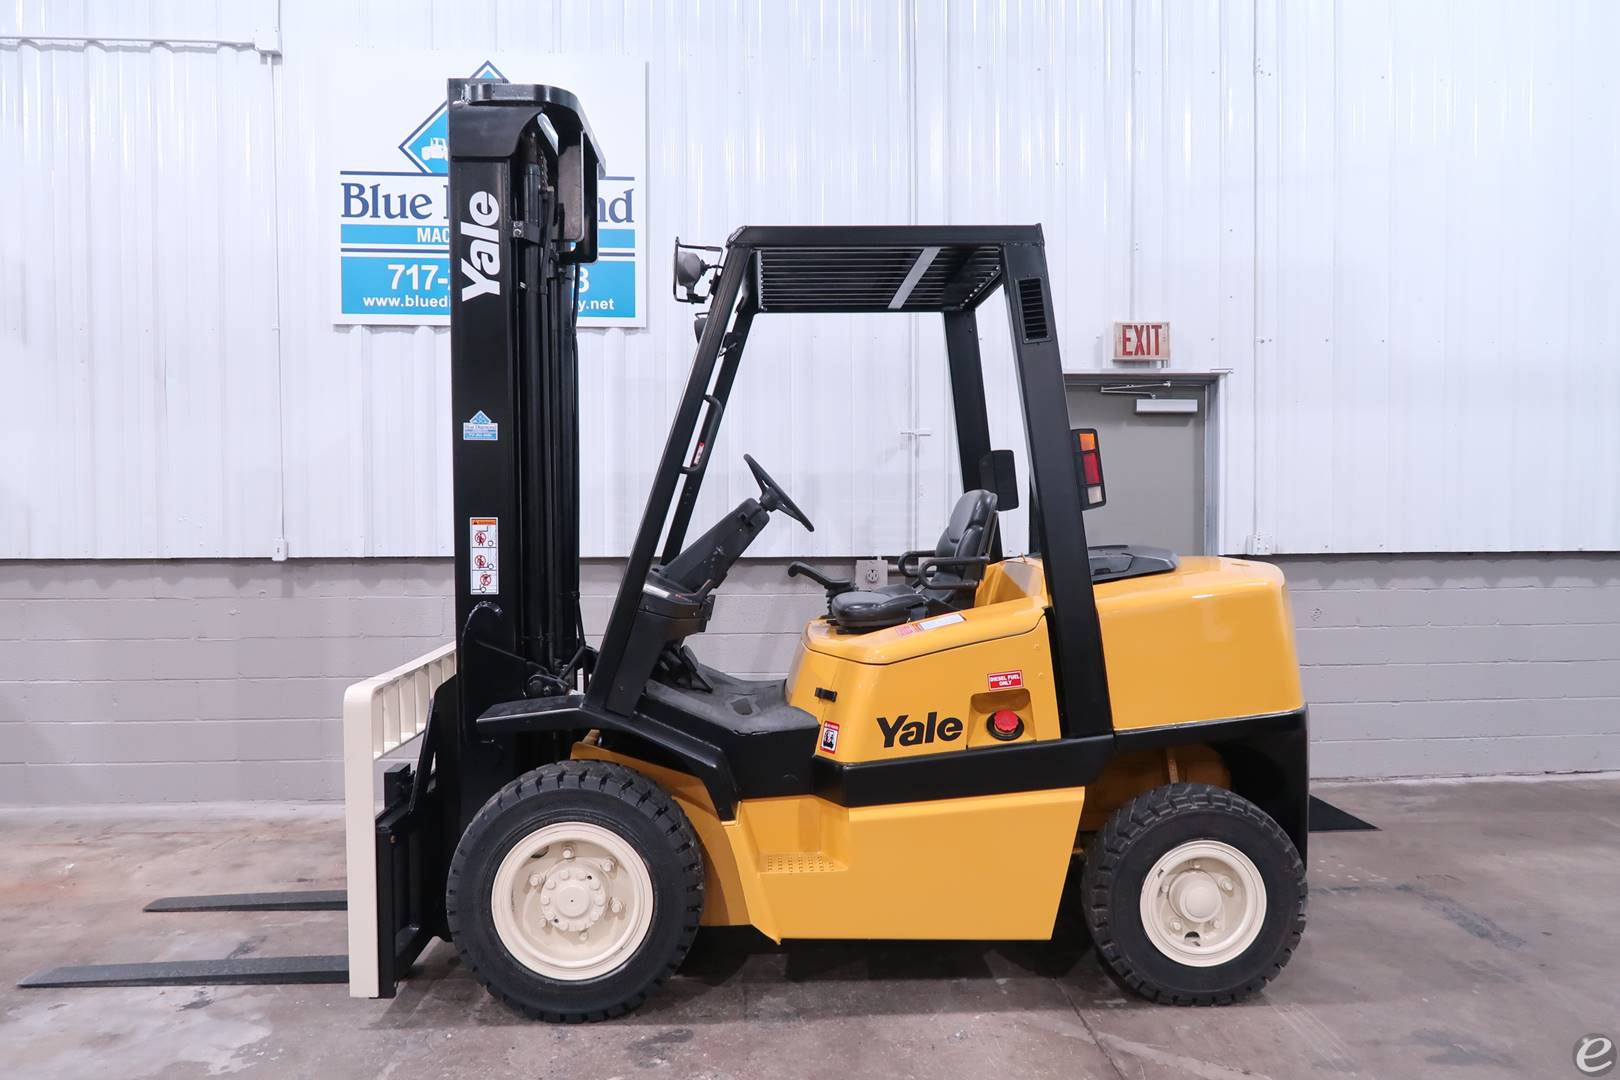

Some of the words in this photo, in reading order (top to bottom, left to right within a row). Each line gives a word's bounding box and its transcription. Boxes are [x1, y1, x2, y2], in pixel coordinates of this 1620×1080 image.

[340, 182, 433, 220] Blue
[598, 188, 635, 223] nd
[416, 227, 450, 243] MAC
[460, 190, 501, 302] Yale
[387, 264, 448, 291] 717-
[363, 294, 449, 307] www.blued
[578, 298, 615, 312] y.net
[1121, 324, 1163, 356] EXIT
[876, 711, 963, 748] Yale
